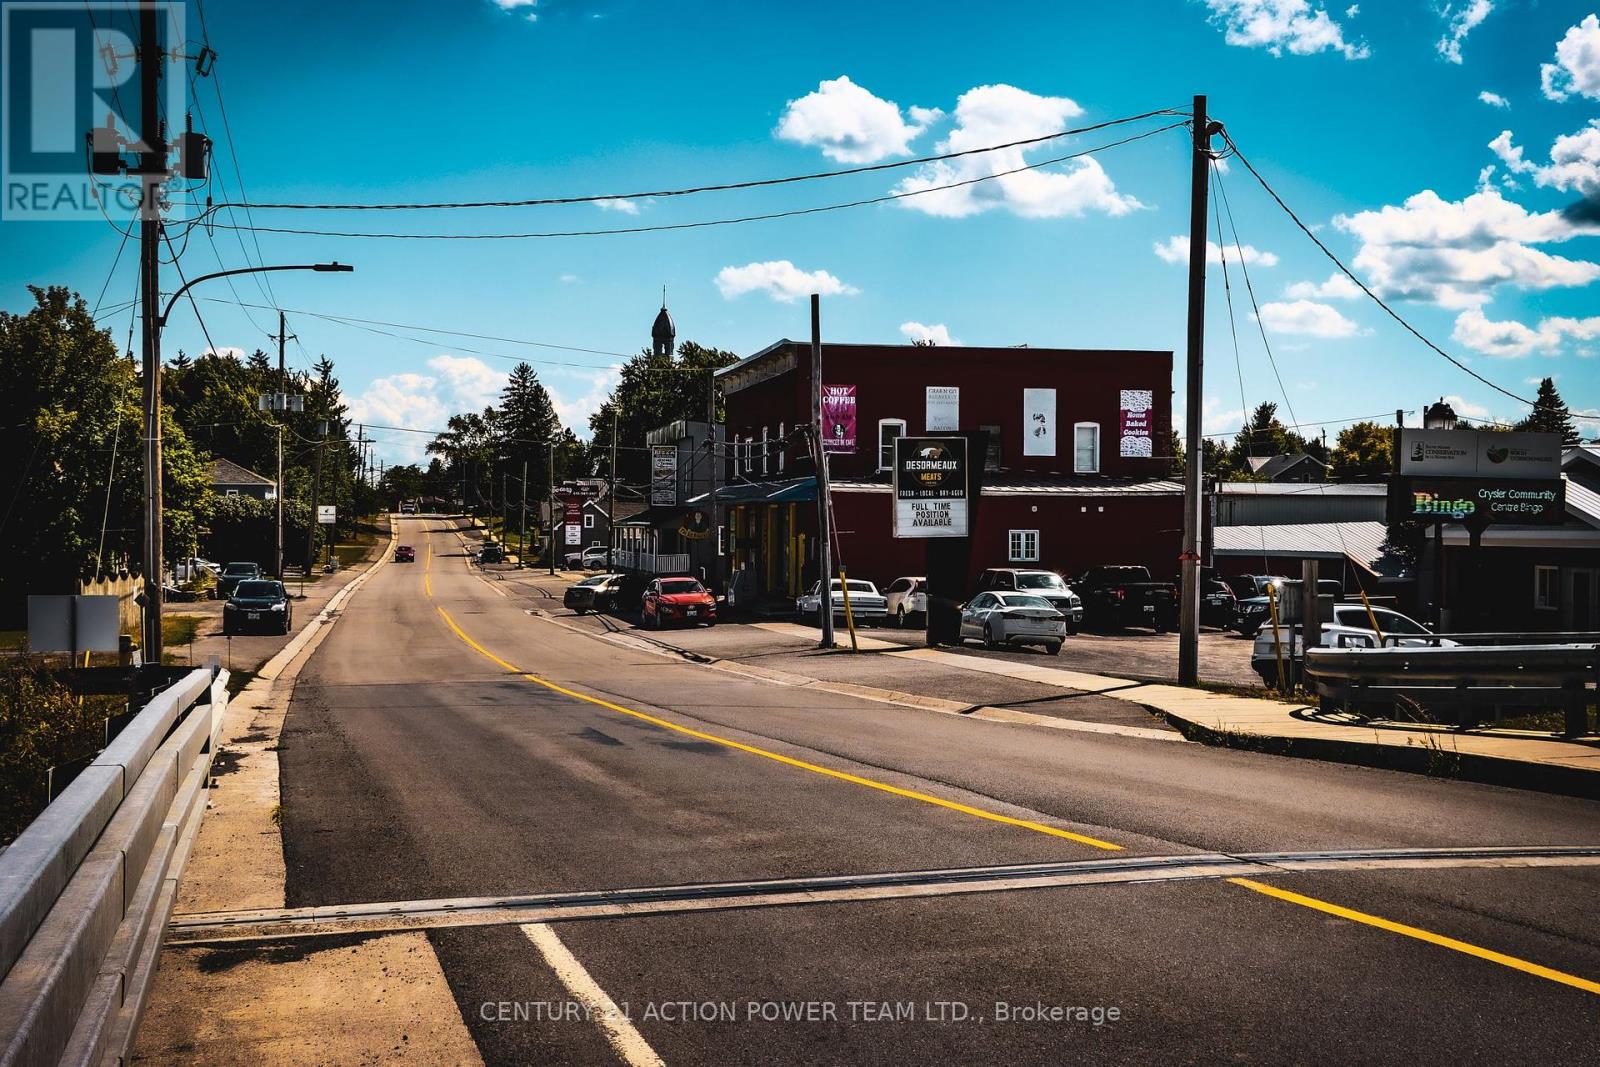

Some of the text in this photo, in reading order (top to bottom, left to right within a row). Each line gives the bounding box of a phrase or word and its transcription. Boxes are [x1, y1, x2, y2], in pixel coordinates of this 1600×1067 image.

[830, 386, 849, 396] HOT
[822, 396, 856, 404] COFFEE
[905, 460, 957, 470] DESORMEAUX
[921, 472, 942, 481] MEATS
[1508, 489, 1556, 502] Community
[911, 502, 951, 511] FULL TIME
[1412, 491, 1476, 519] Bingo
[1491, 502, 1544, 515] Centre Bingo
[915, 510, 949, 519] POSITION
[912, 519, 952, 527] AVAILABLE
